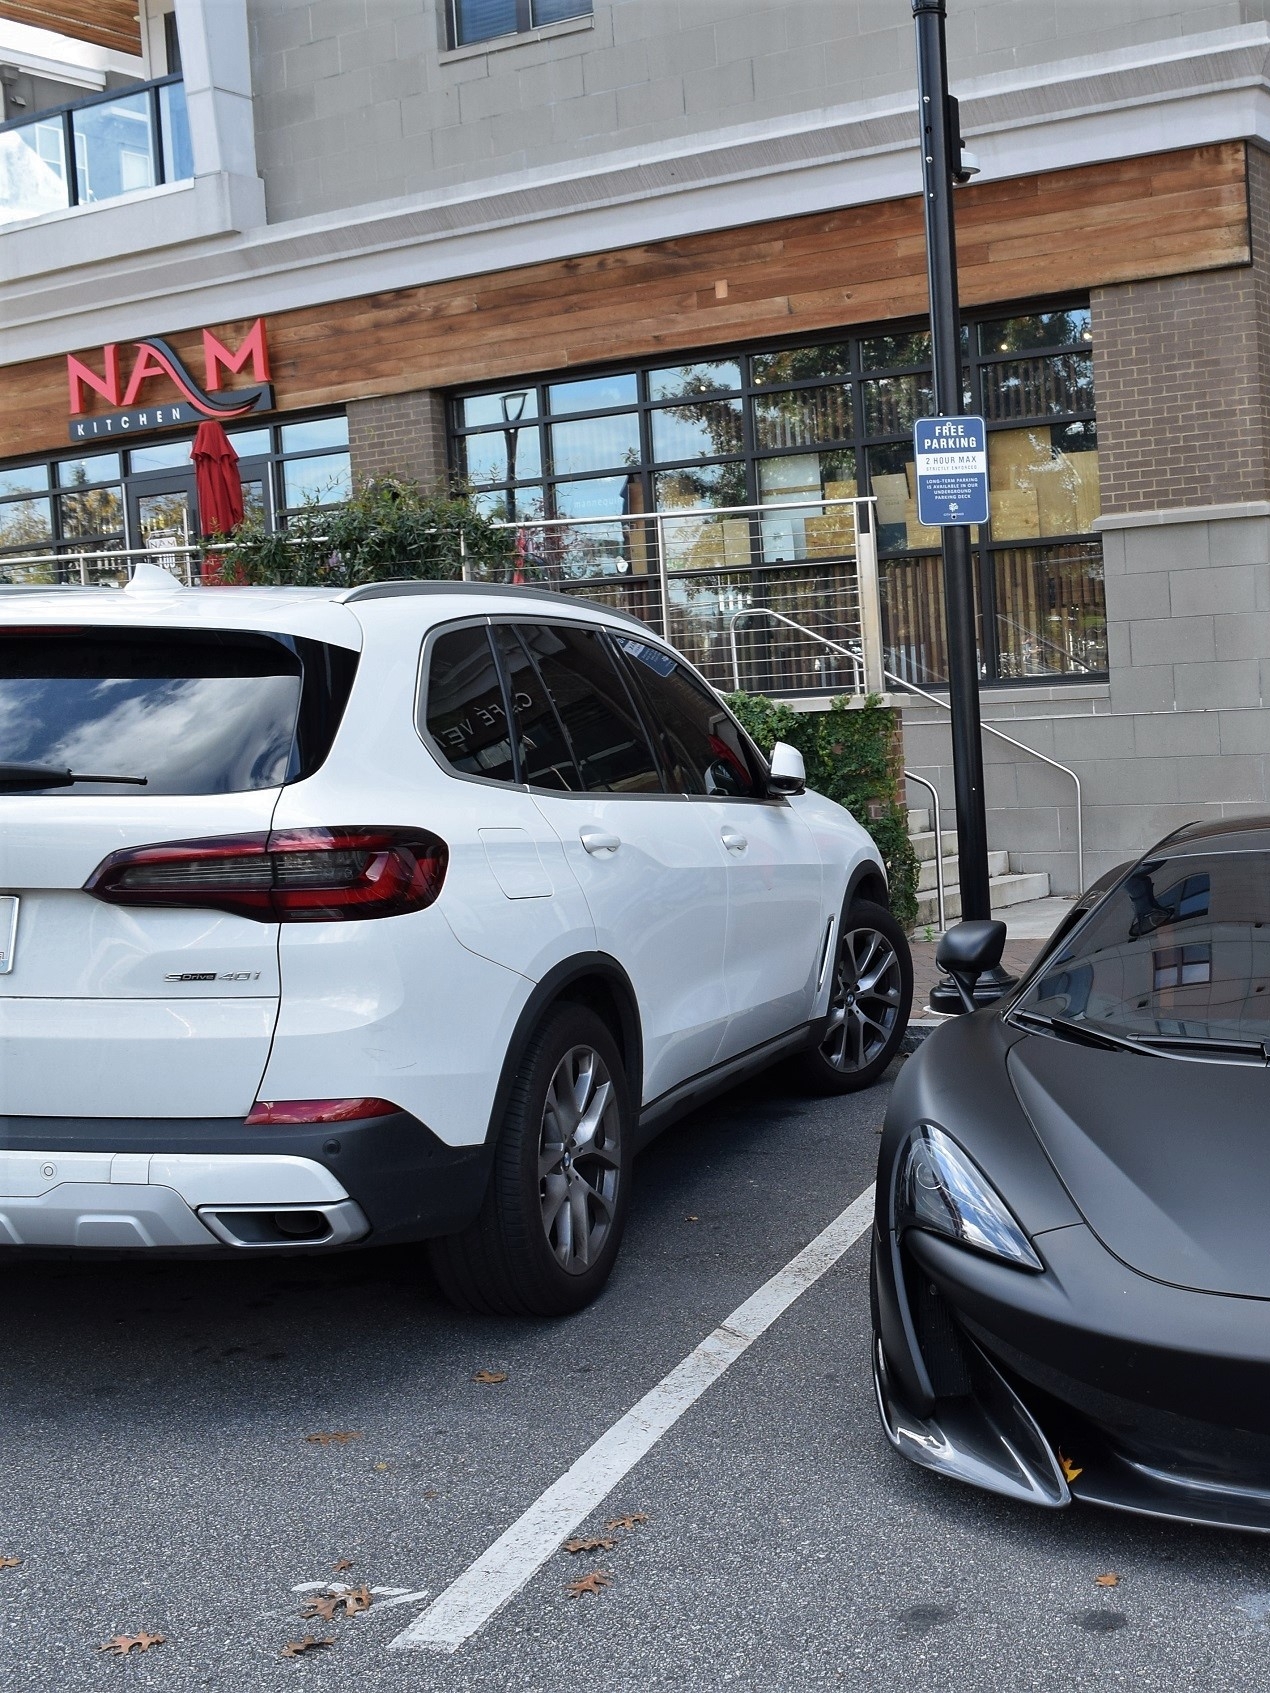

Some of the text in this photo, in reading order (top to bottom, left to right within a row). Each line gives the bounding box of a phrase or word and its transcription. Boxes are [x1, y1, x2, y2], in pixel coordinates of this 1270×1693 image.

[67, 317, 272, 417] NAM
[77, 407, 181, 436] KITCHEN
[935, 425, 964, 437] FREE
[924, 437, 977, 450] PARKING
[925, 455, 977, 465] 2 HOUR MAX
